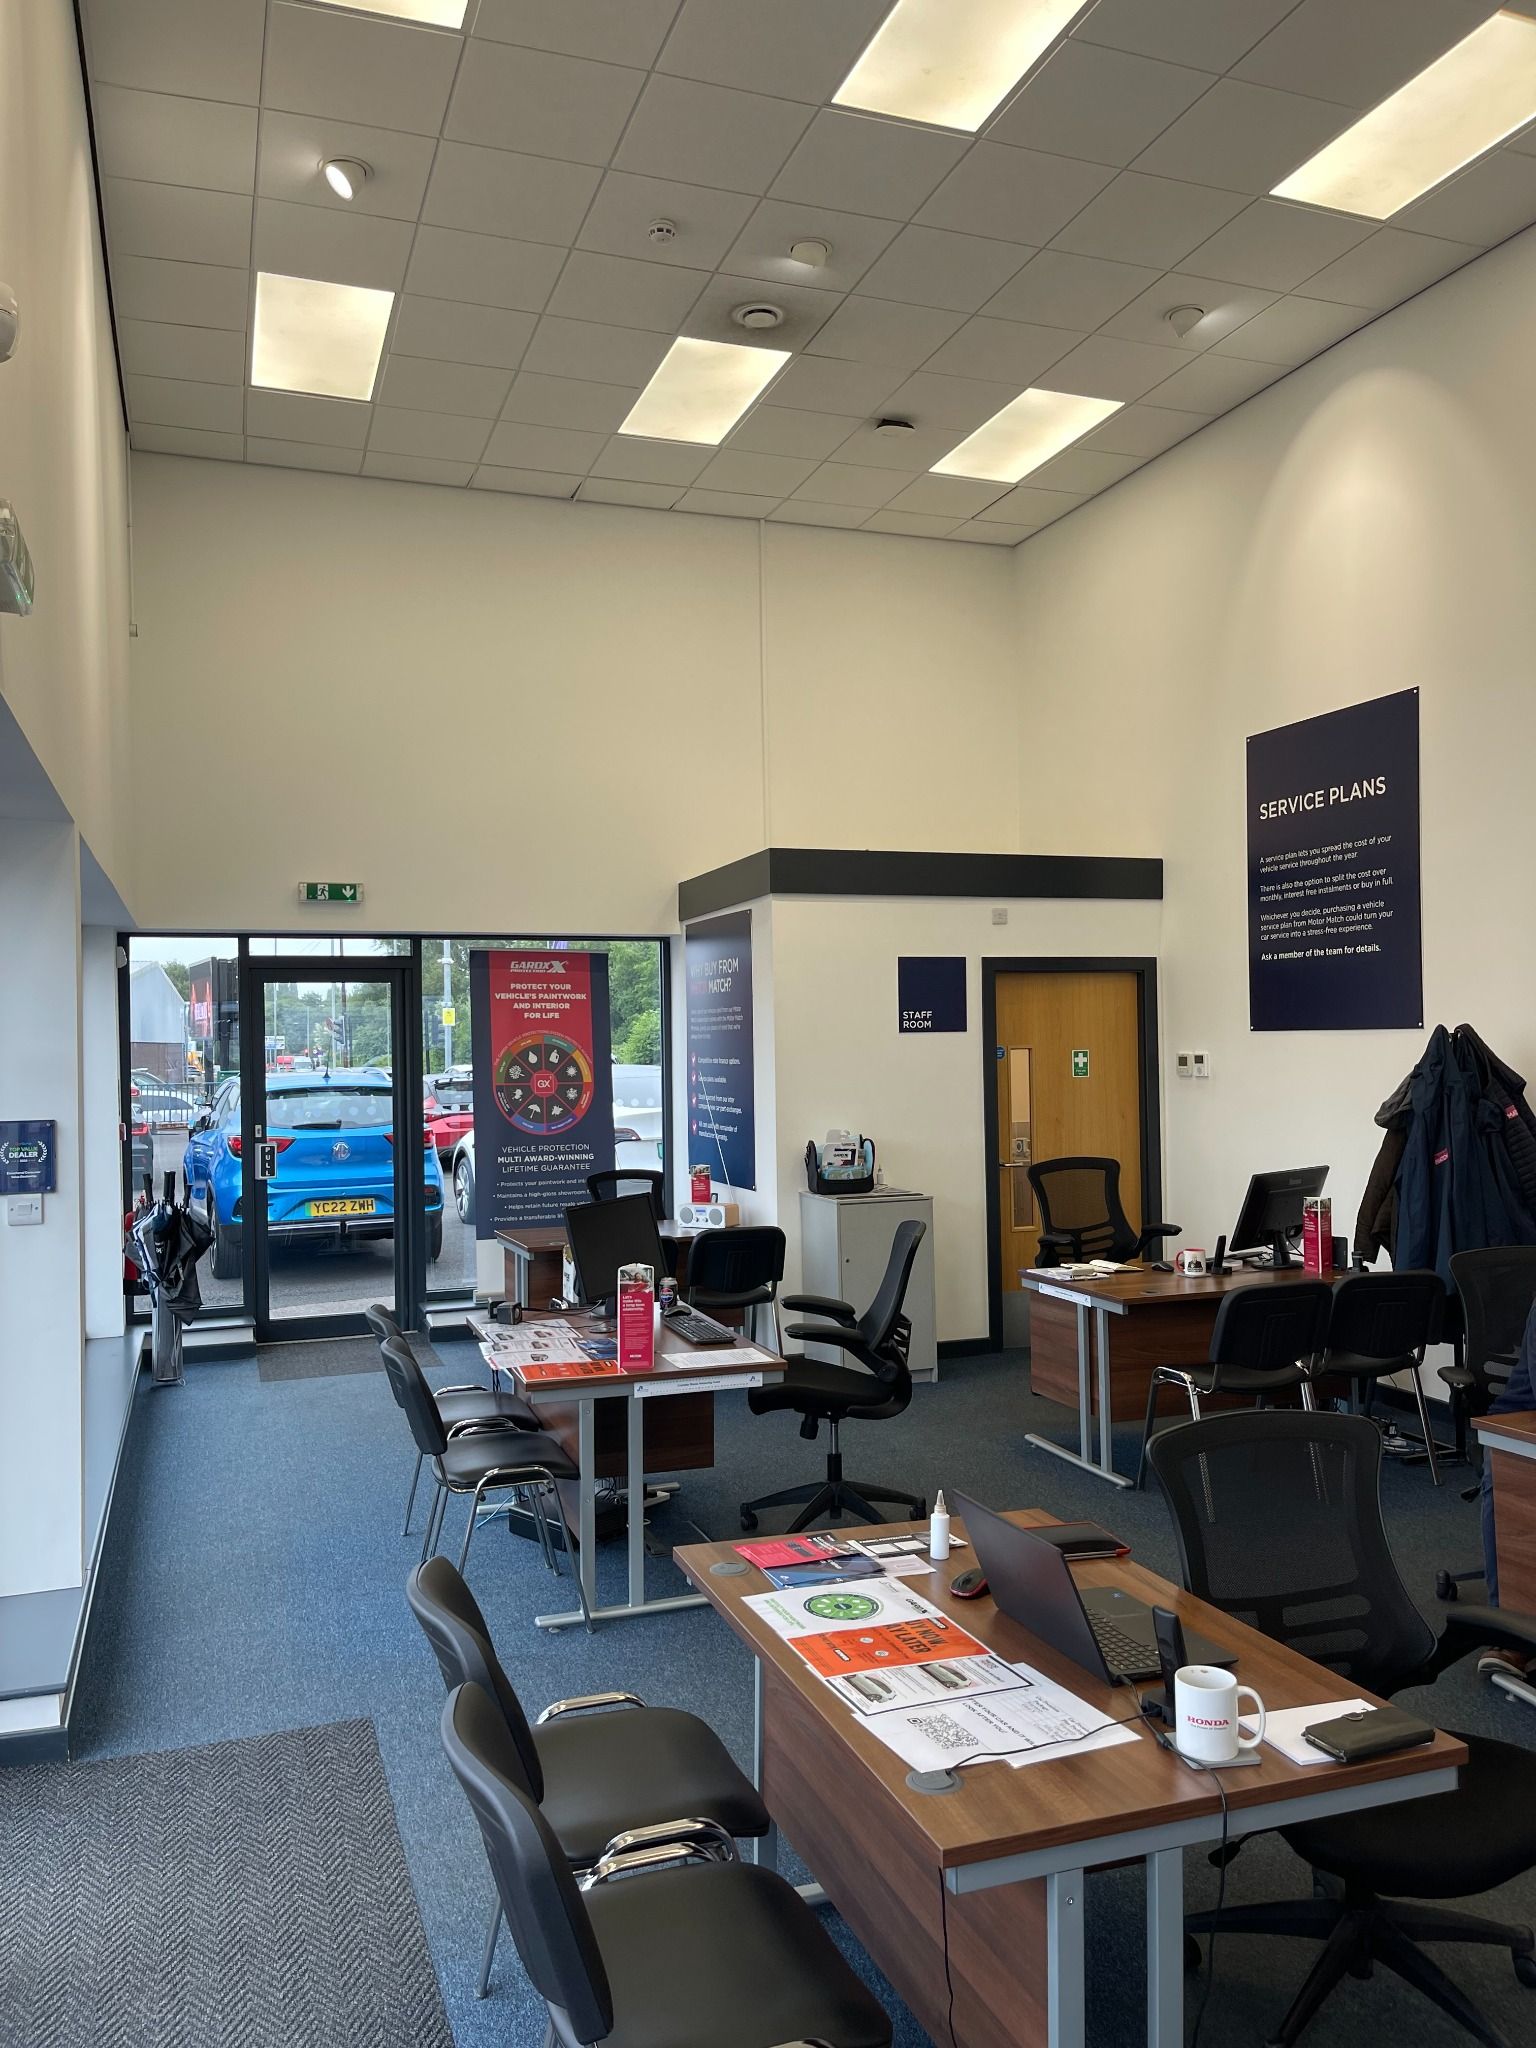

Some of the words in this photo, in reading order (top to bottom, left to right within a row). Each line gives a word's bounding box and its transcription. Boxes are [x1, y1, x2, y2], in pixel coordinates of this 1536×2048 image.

[1260, 790, 1324, 820] SERVICE
[1329, 776, 1386, 805] PLANS
[1266, 854, 1284, 862] service
[1285, 852, 1297, 861] plan
[1310, 848, 1320, 856] you
[1322, 843, 1342, 853] spread
[1343, 841, 1352, 850] the
[1354, 838, 1367, 847] cost
[1369, 836, 1376, 844] of
[1377, 835, 1392, 844] your
[1260, 865, 1278, 874] vehicle
[1280, 862, 1298, 870] service
[1300, 856, 1332, 867] throughout
[1260, 885, 1275, 893] There
[1304, 878, 1323, 887] option
[1332, 873, 1344, 882] split
[1358, 870, 1370, 878] cost
[1284, 890, 1304, 900] interest
[1306, 888, 1317, 896] free
[1318, 884, 1352, 894] instalments
[1361, 881, 1374, 890] buy
[1260, 912, 1288, 922] Whichever
[1290, 911, 1300, 920] you
[1322, 904, 1355, 914] purchasing
[1362, 900, 1384, 909] vehicle
[1280, 922, 1292, 930] plan
[1308, 917, 1324, 926] Motor
[1326, 915, 1344, 924] Match
[1346, 912, 1362, 921] could
[1364, 911, 1377, 920] turn
[1378, 910, 1393, 919] your
[1270, 932, 1289, 940] service
[1308, 926, 1337, 936] stress-free
[1278, 950, 1304, 959] member
[1306, 949, 1312, 957] of
[1314, 948, 1324, 956] the
[1326, 946, 1342, 955] team
[1344, 946, 1354, 954] for
[1356, 944, 1381, 953] details.
[704, 960, 718, 976] BUY
[718, 957, 739, 974] FROM
[708, 977, 732, 993] MATCH?
[902, 1010, 932, 1019] STAFF
[903, 1020, 932, 1028] ROOM
[502, 1145, 536, 1154] VEHICLE
[538, 1144, 590, 1152] PROTECTION
[524, 1153, 594, 1163] AWARD-WINNING
[502, 1165, 538, 1174] LIFETIME
[541, 1162, 590, 1172] GUARANTEE
[314, 1202, 348, 1214] YC22
[350, 1200, 374, 1211] ZWH
[883, 1624, 908, 1632] AY
[904, 1620, 928, 1630] UY
[916, 1629, 948, 1648] NOW,
[894, 1632, 932, 1654] LATER
[1188, 1716, 1230, 1726] HONDA
